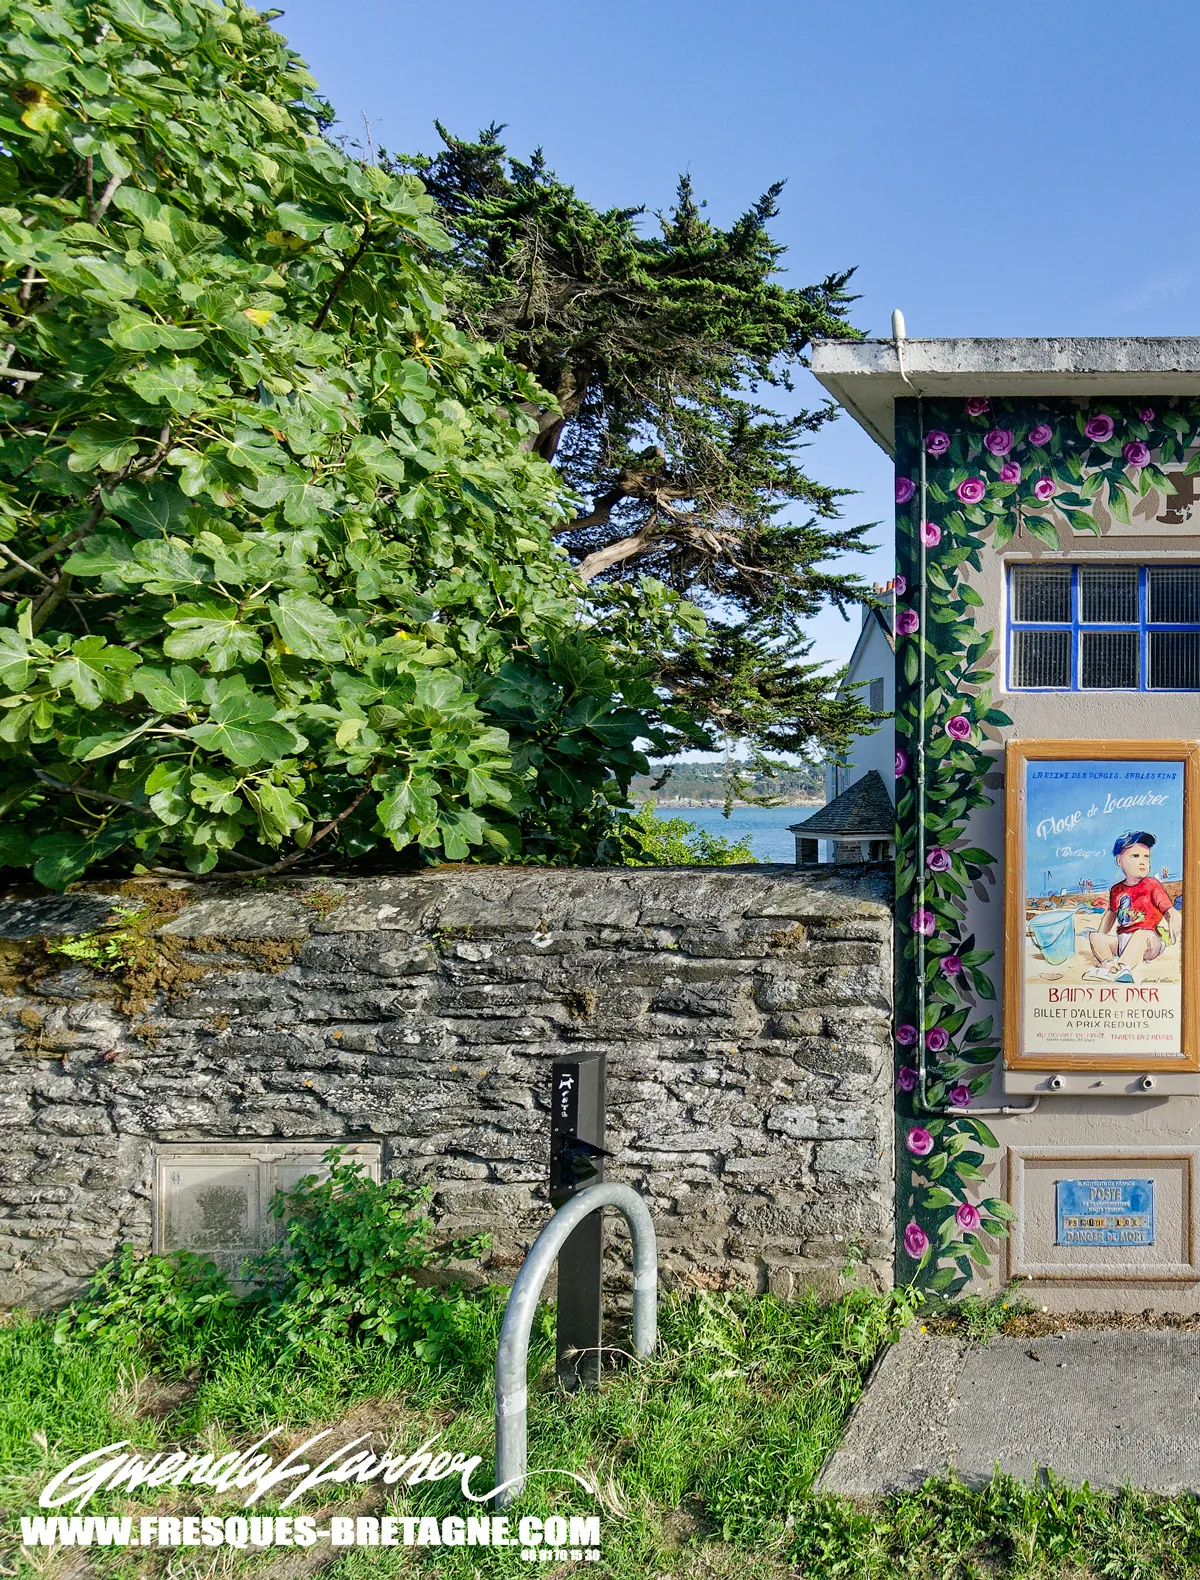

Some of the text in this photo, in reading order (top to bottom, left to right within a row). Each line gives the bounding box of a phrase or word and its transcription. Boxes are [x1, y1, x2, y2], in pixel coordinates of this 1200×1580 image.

[1036, 810, 1082, 841] Plage
[1086, 803, 1099, 818] de
[1048, 987, 1160, 1003] BAINS DE MER
[1033, 1008, 1175, 1019] BILLET D'ALLER ET RETOURS
[1089, 1187, 1122, 1201] POSTE
[1066, 1231, 1146, 1242] DANGER DE MORT
